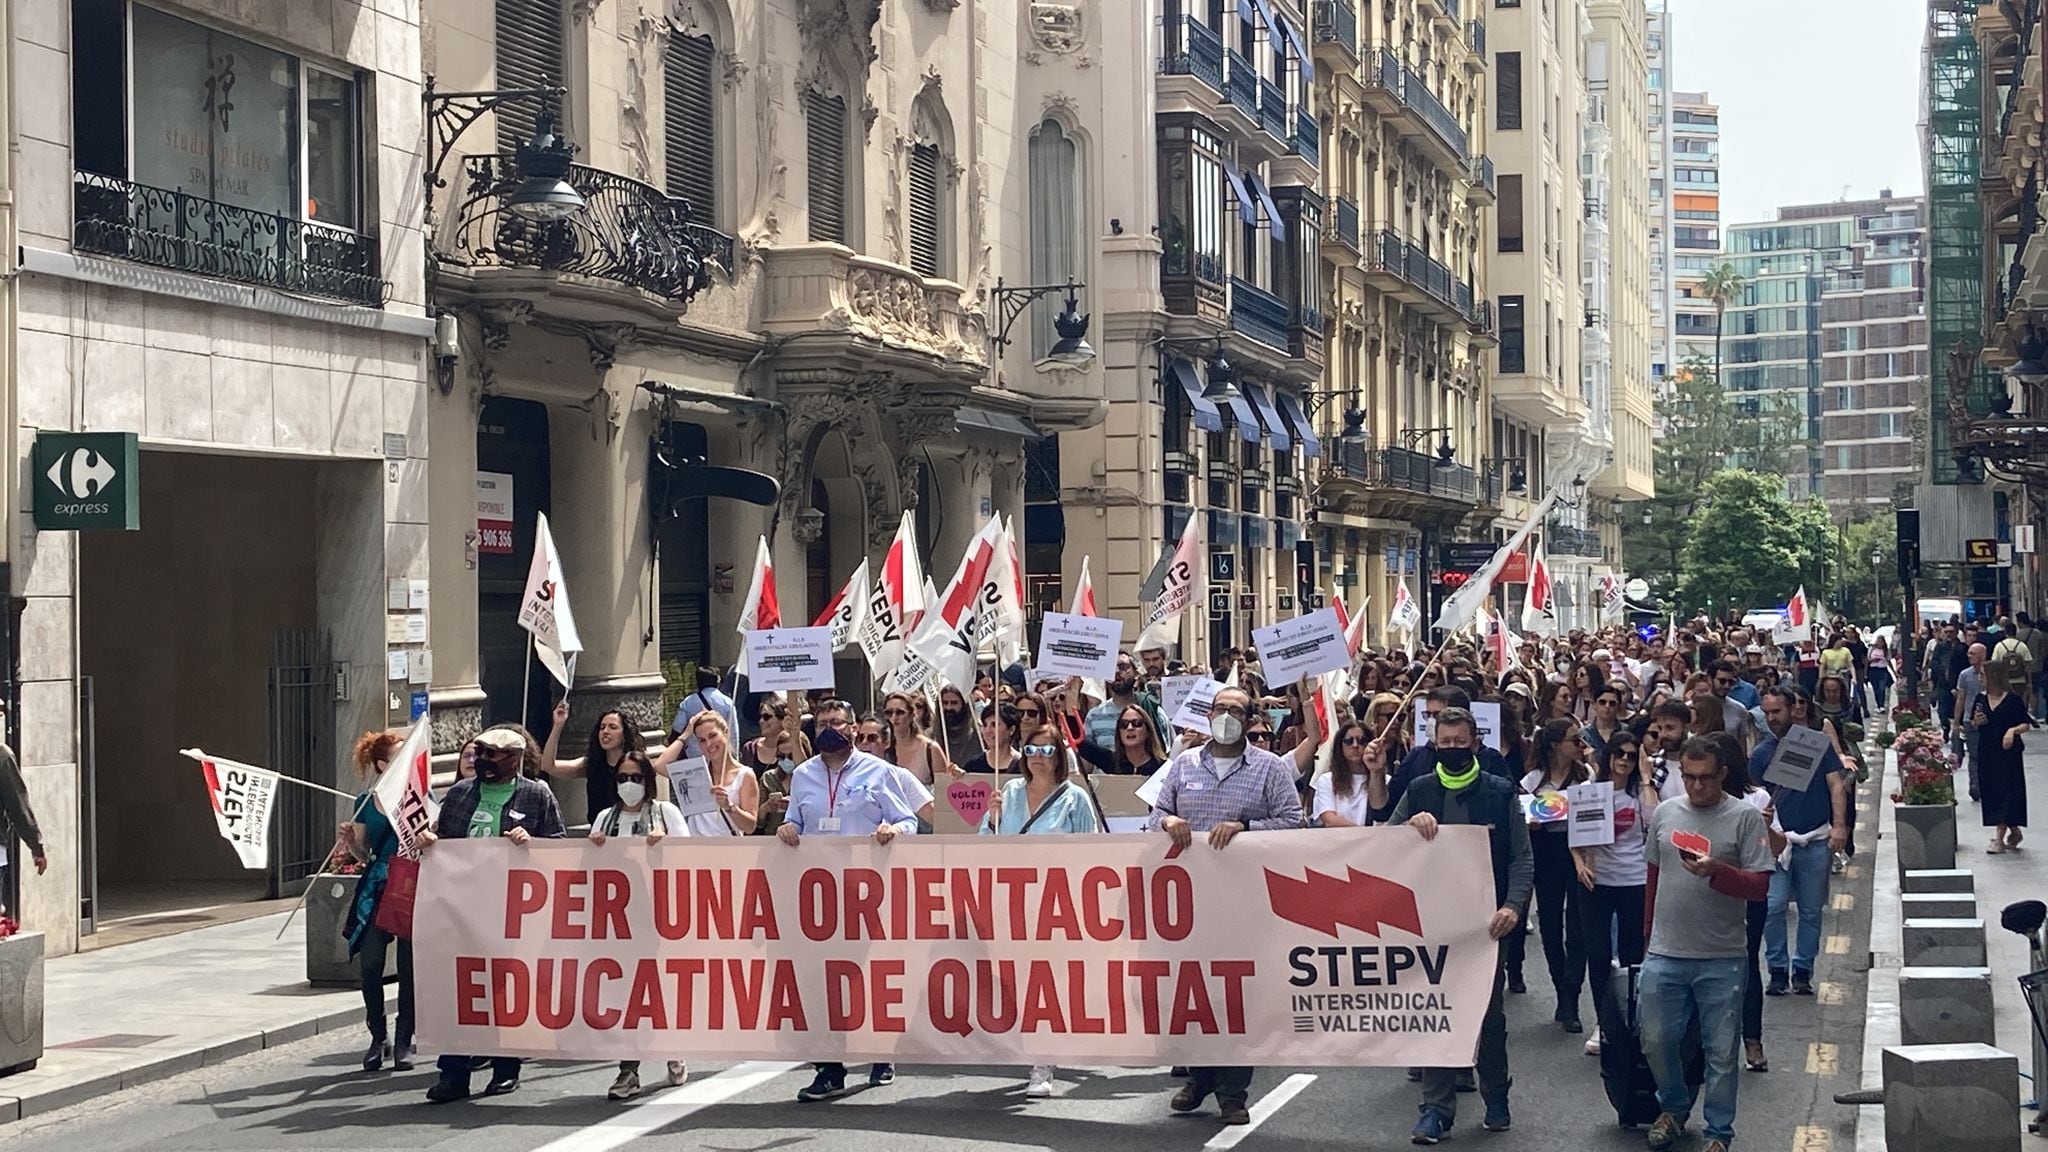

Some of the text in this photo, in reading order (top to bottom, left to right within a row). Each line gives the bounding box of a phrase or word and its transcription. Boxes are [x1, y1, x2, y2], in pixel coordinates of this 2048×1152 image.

[54, 503, 109, 517] express
[483, 529, 498, 548] 906
[498, 529, 513, 548] 356
[504, 845, 1194, 942] PER UNA ORIENTACIÓ
[1288, 945, 1449, 987] STEPV
[455, 956, 1255, 1038] EDUCATIVA DE QUALITAT
[1291, 991, 1453, 1012] INTERSINDICAL
[1318, 1014, 1451, 1034] VALENCIANA
